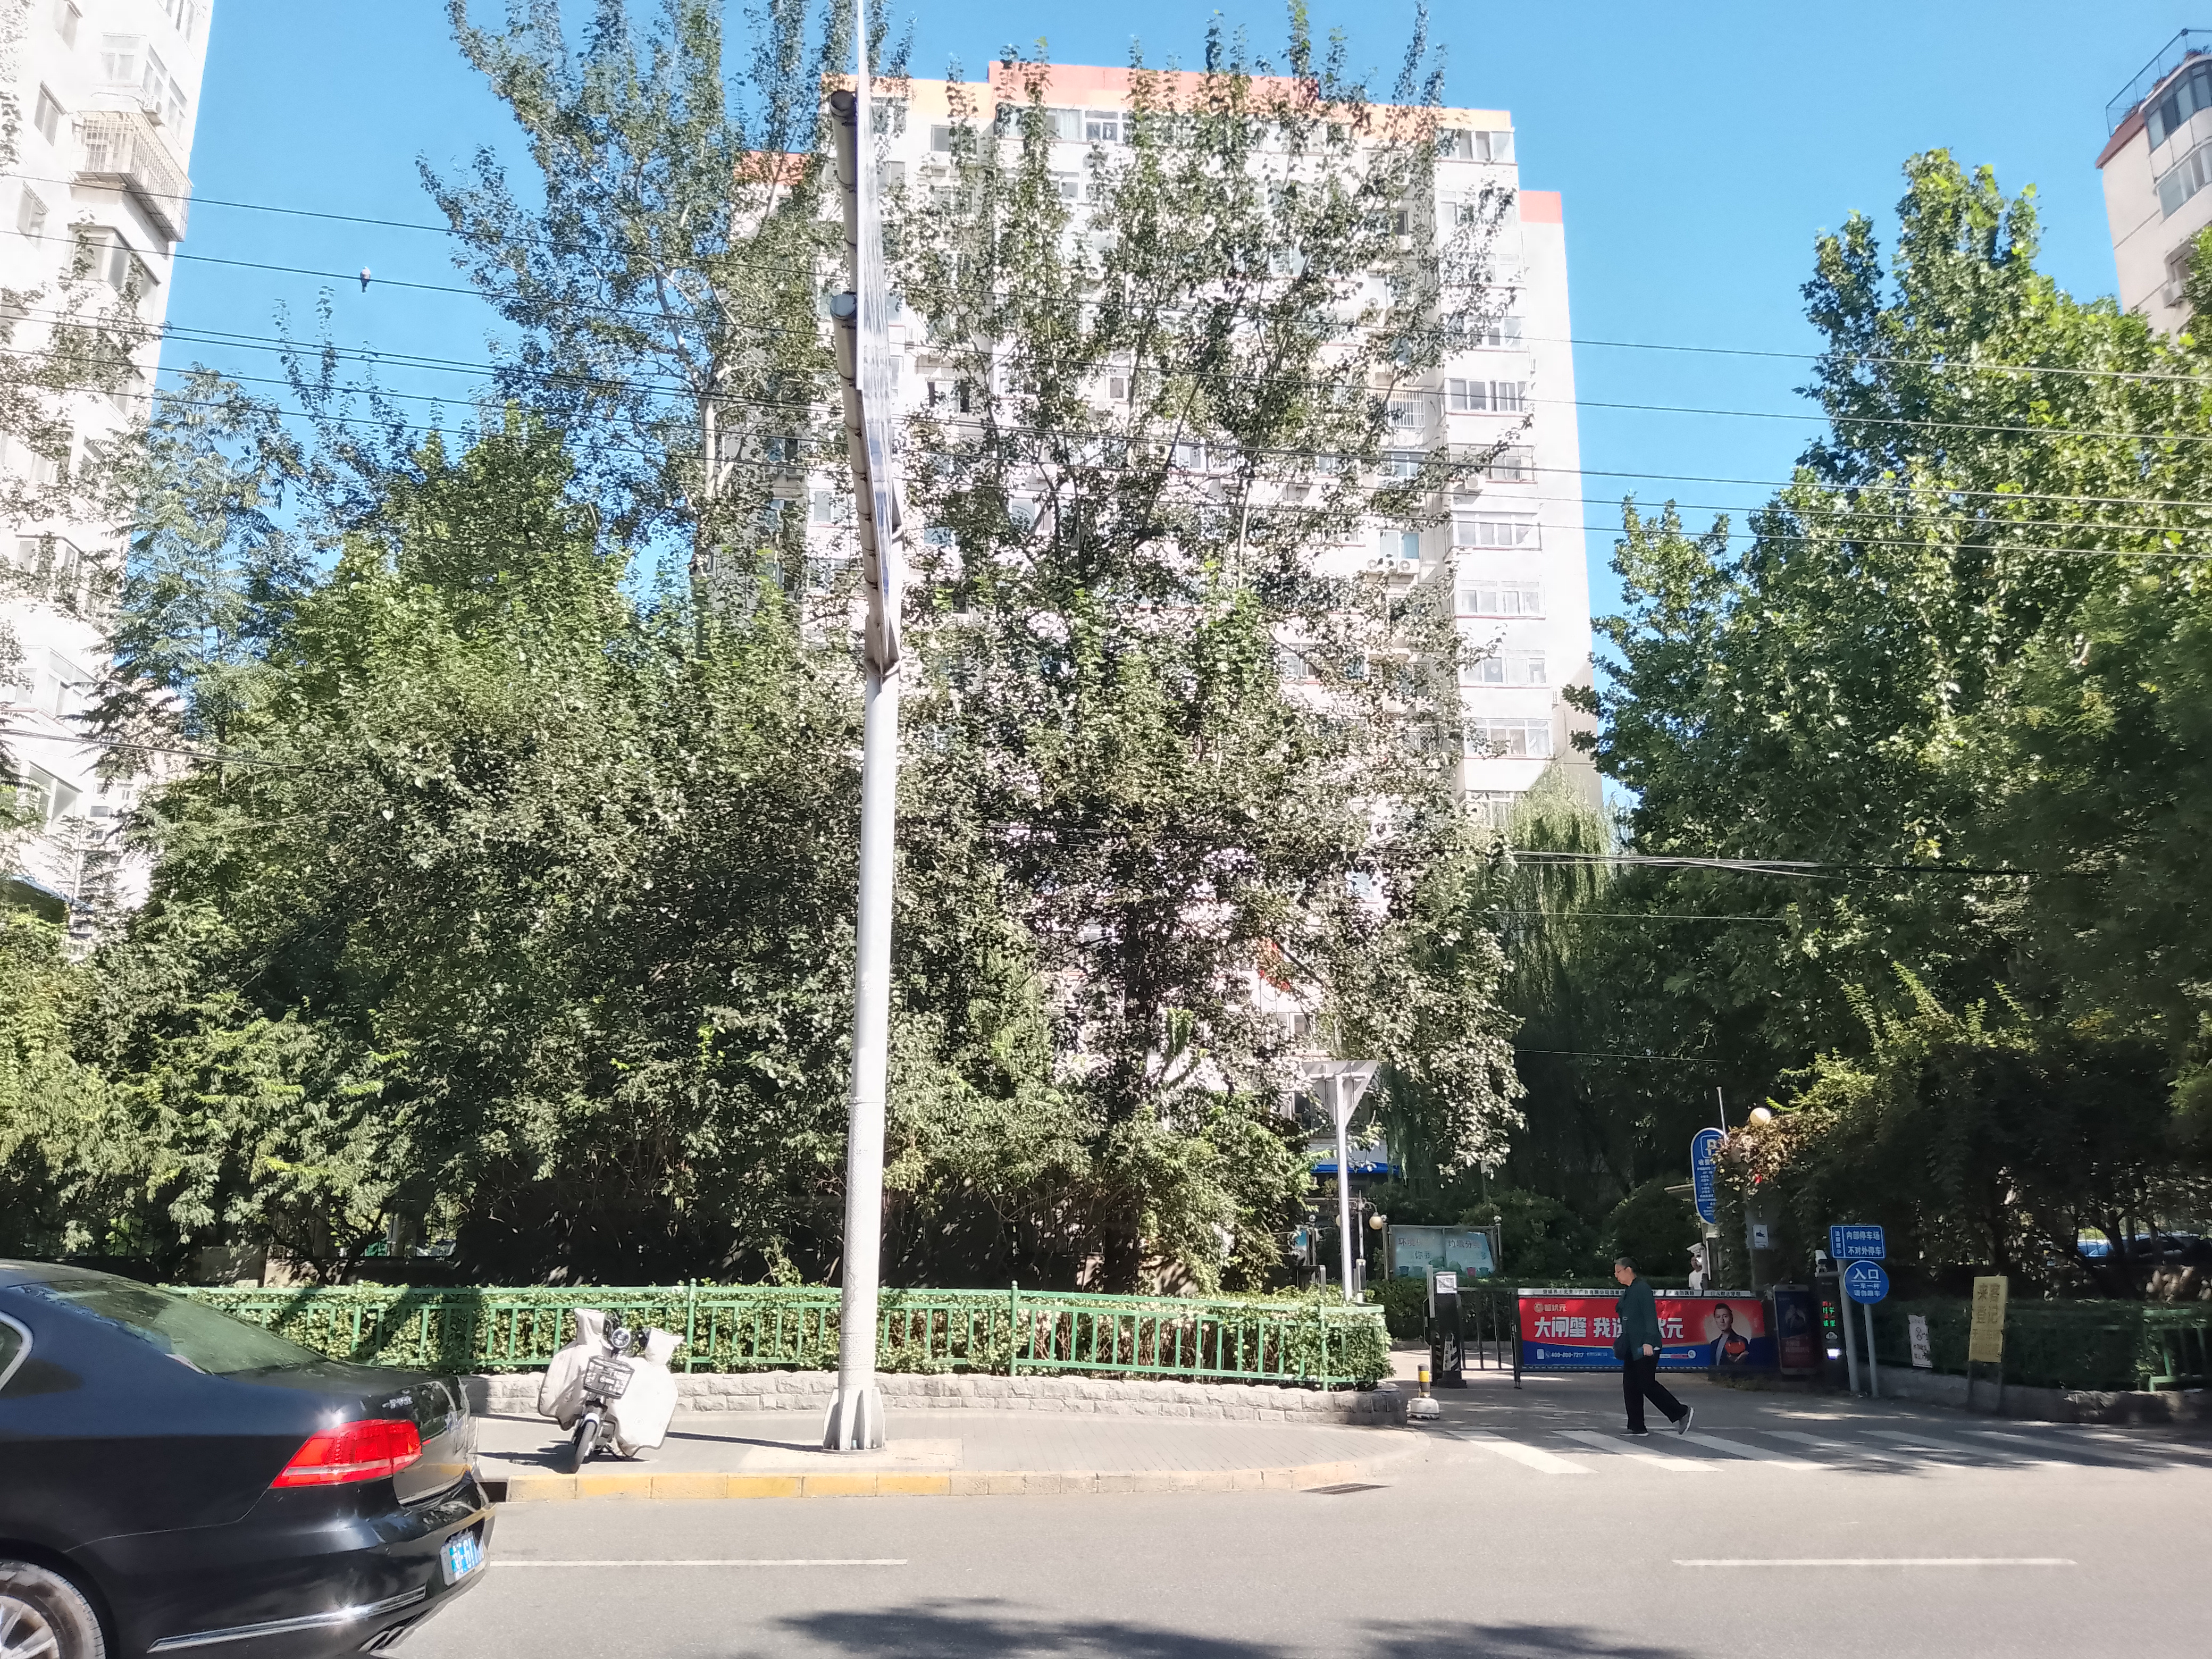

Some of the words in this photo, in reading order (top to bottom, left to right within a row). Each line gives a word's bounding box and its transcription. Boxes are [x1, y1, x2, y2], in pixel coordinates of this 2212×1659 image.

[1846, 1230, 1881, 1241] 内部停车场
[1847, 1245, 1882, 1256] 不对外停车
[1853, 1268, 1880, 1280] 入口
[1977, 1283, 2000, 1302] 来客
[1975, 1305, 1998, 1324] 登记
[1534, 1316, 1587, 1338] 大闸蟹
